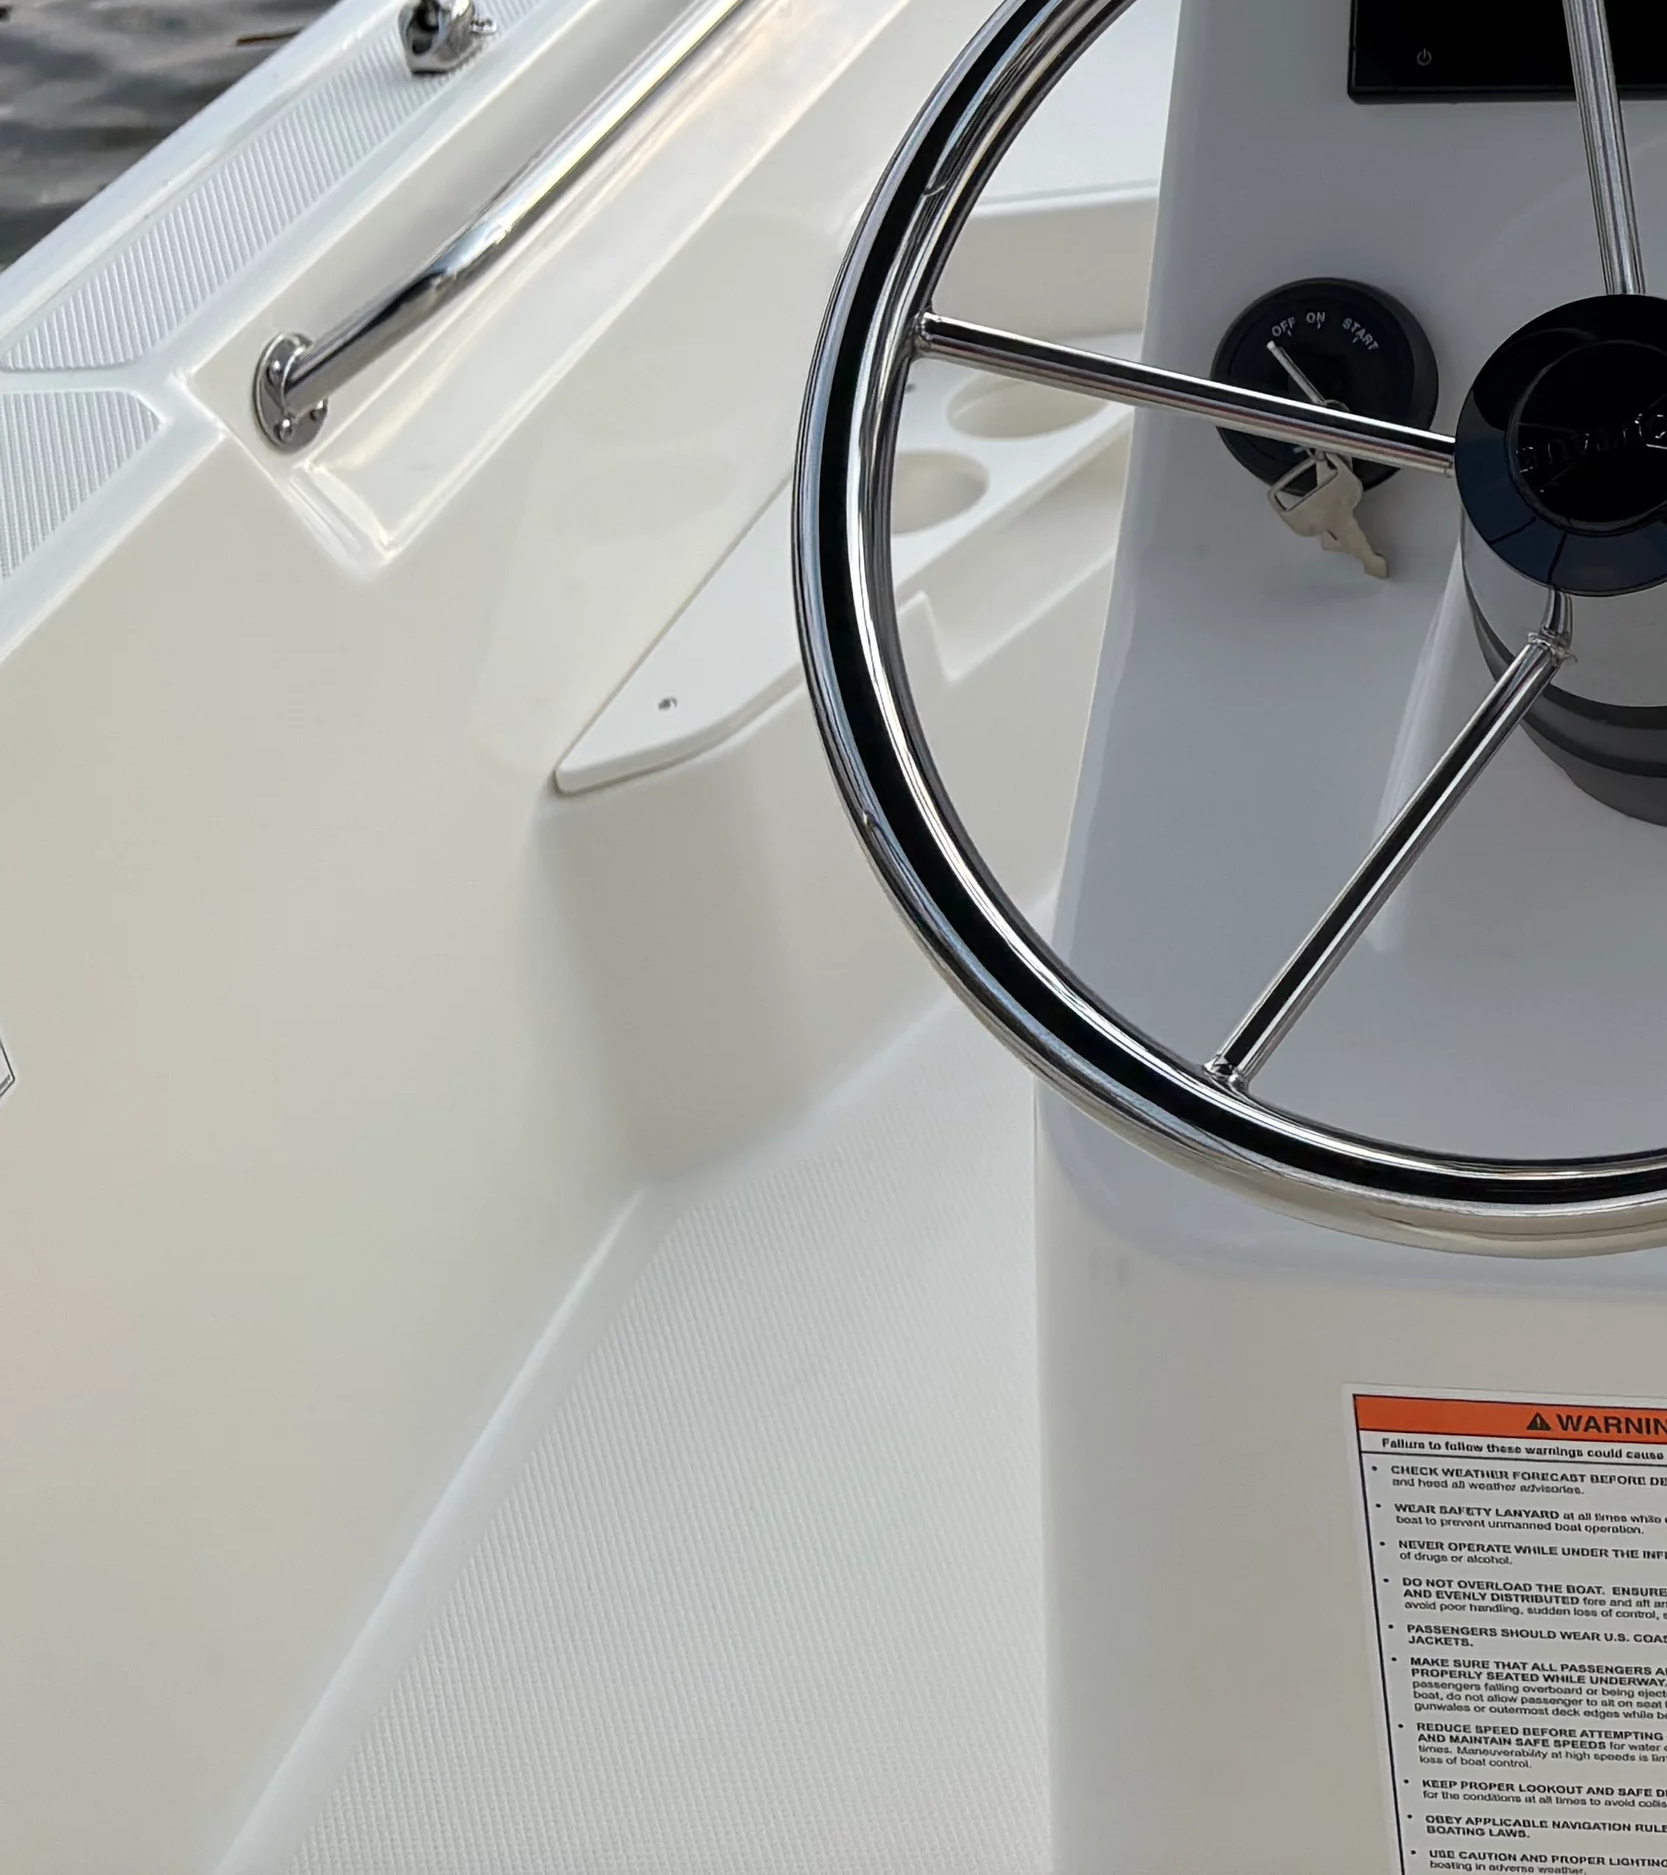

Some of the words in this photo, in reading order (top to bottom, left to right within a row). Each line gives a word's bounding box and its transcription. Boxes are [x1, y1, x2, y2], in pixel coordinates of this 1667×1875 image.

[1306, 311, 1326, 324] ON
[1271, 316, 1297, 338] OFF
[1342, 317, 1380, 352] START
[1407, 1624, 1497, 1637] PASSENGERS
[1501, 1628, 1557, 1639] SHOULD
[1559, 1631, 1601, 1642] WEAR
[1603, 1632, 1630, 1642] U.S.
[1408, 1635, 1473, 1647] JACKETS.
